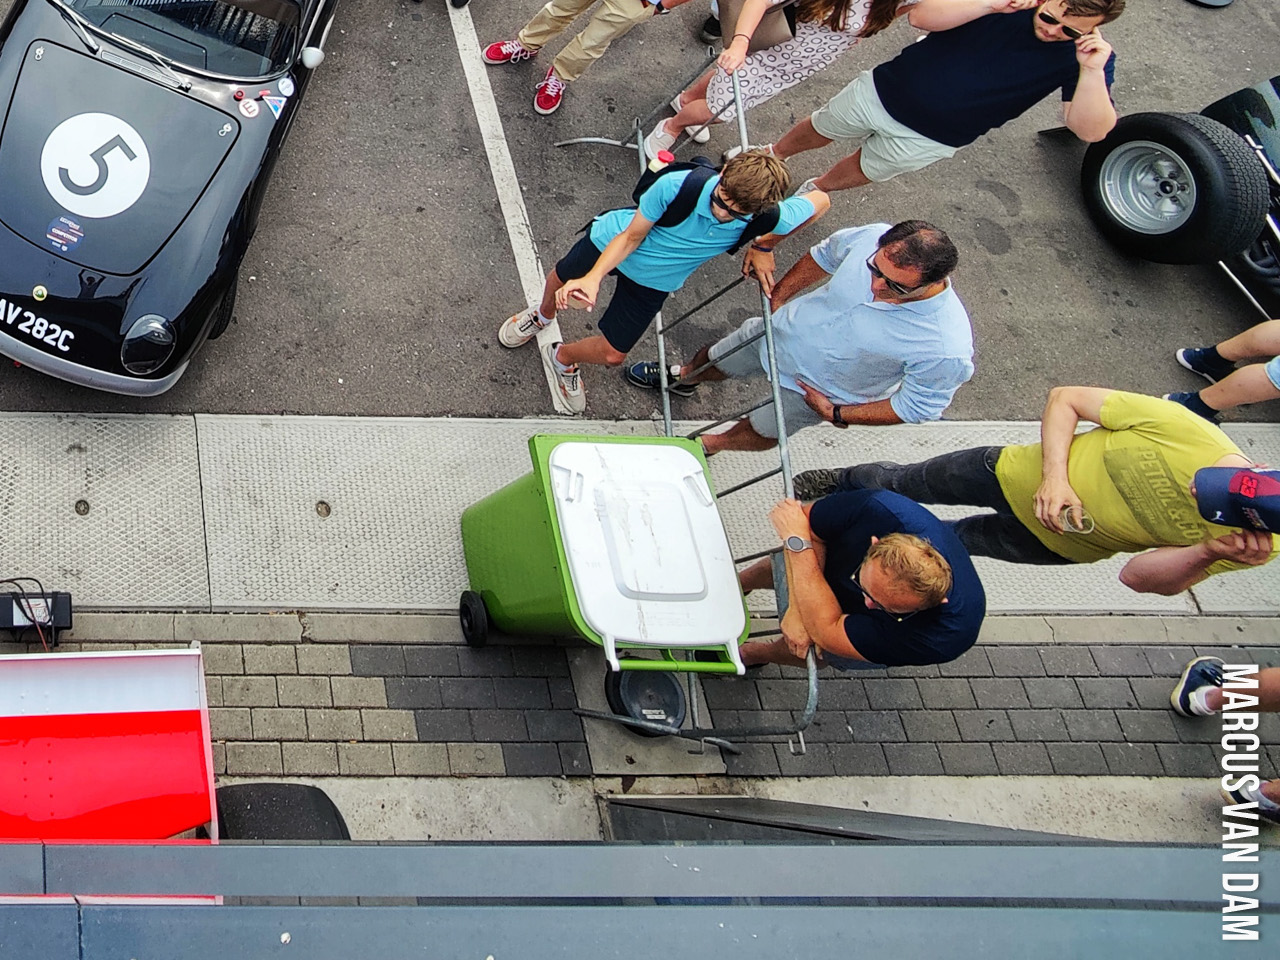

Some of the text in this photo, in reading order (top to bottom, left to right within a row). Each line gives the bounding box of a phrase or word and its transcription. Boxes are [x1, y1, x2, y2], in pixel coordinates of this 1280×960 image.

[58, 133, 138, 196] 5
[17, 310, 75, 352] 282C
[1139, 451, 1178, 508] PETROL
